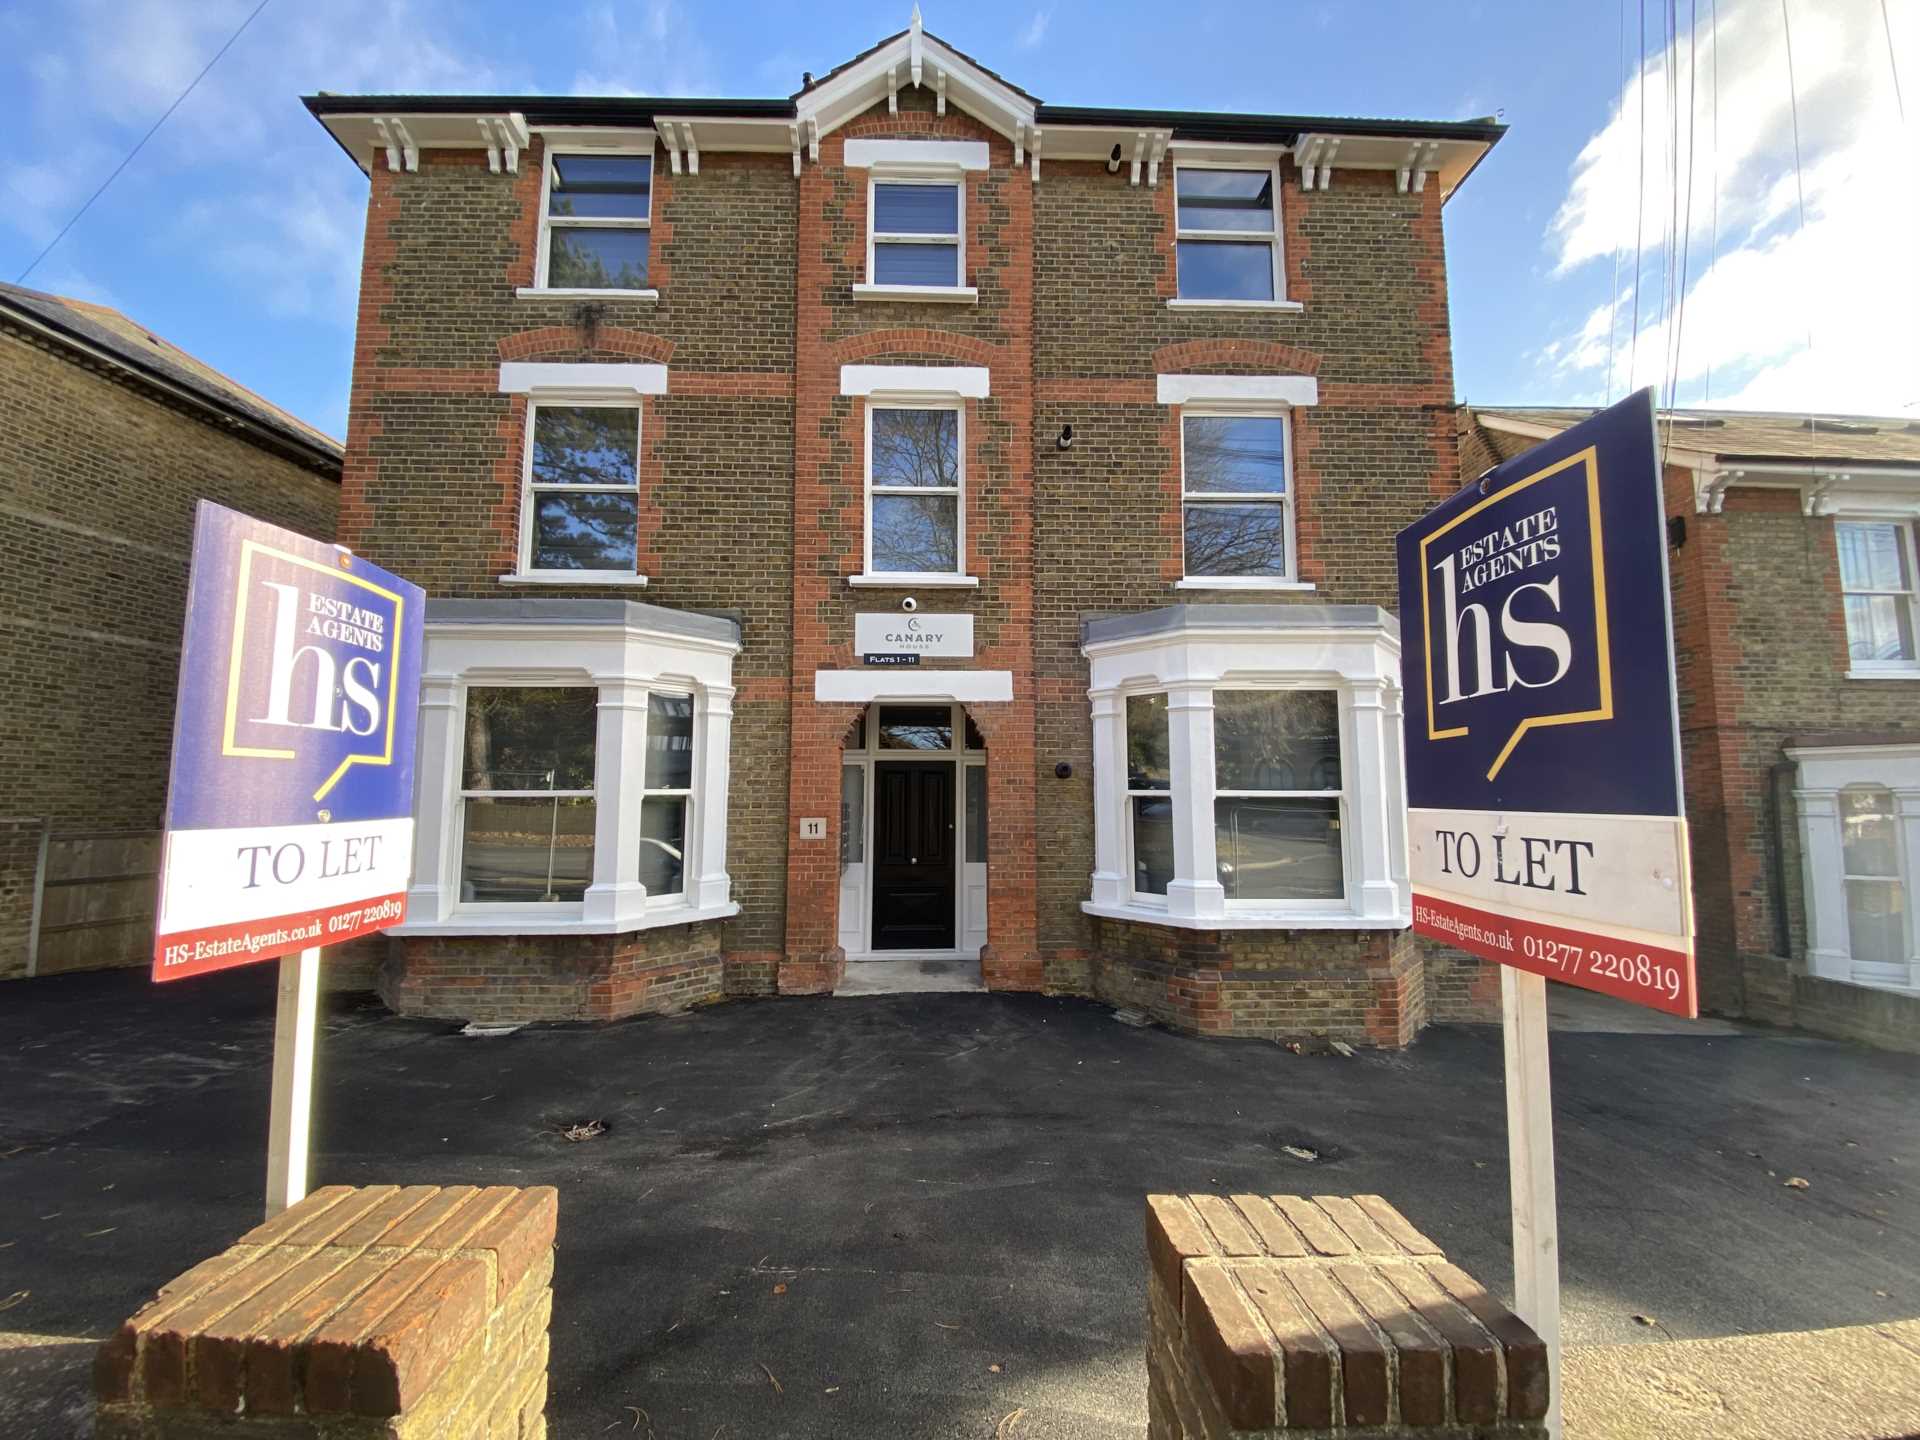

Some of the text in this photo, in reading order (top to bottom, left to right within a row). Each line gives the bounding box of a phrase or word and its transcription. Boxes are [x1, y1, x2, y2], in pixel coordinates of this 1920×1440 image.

[1460, 506, 1558, 570] ESTATE
[1461, 533, 1561, 594] AGENTS
[305, 615, 383, 653] AGENTS
[307, 592, 384, 634] ESTATE
[884, 633, 943, 643] CANARY
[1433, 553, 1572, 705] hs
[248, 581, 380, 736] hs
[869, 655, 895, 663] FLATS
[807, 822, 818, 834] 11
[237, 835, 383, 889] TO LET
[1436, 830, 1594, 895] TO LET
[164, 900, 403, 966] HS-EstateAgents.co.uk 01277 220819
[1415, 905, 1680, 1000] HS-EstateAgents.co.uk 01277 220819
